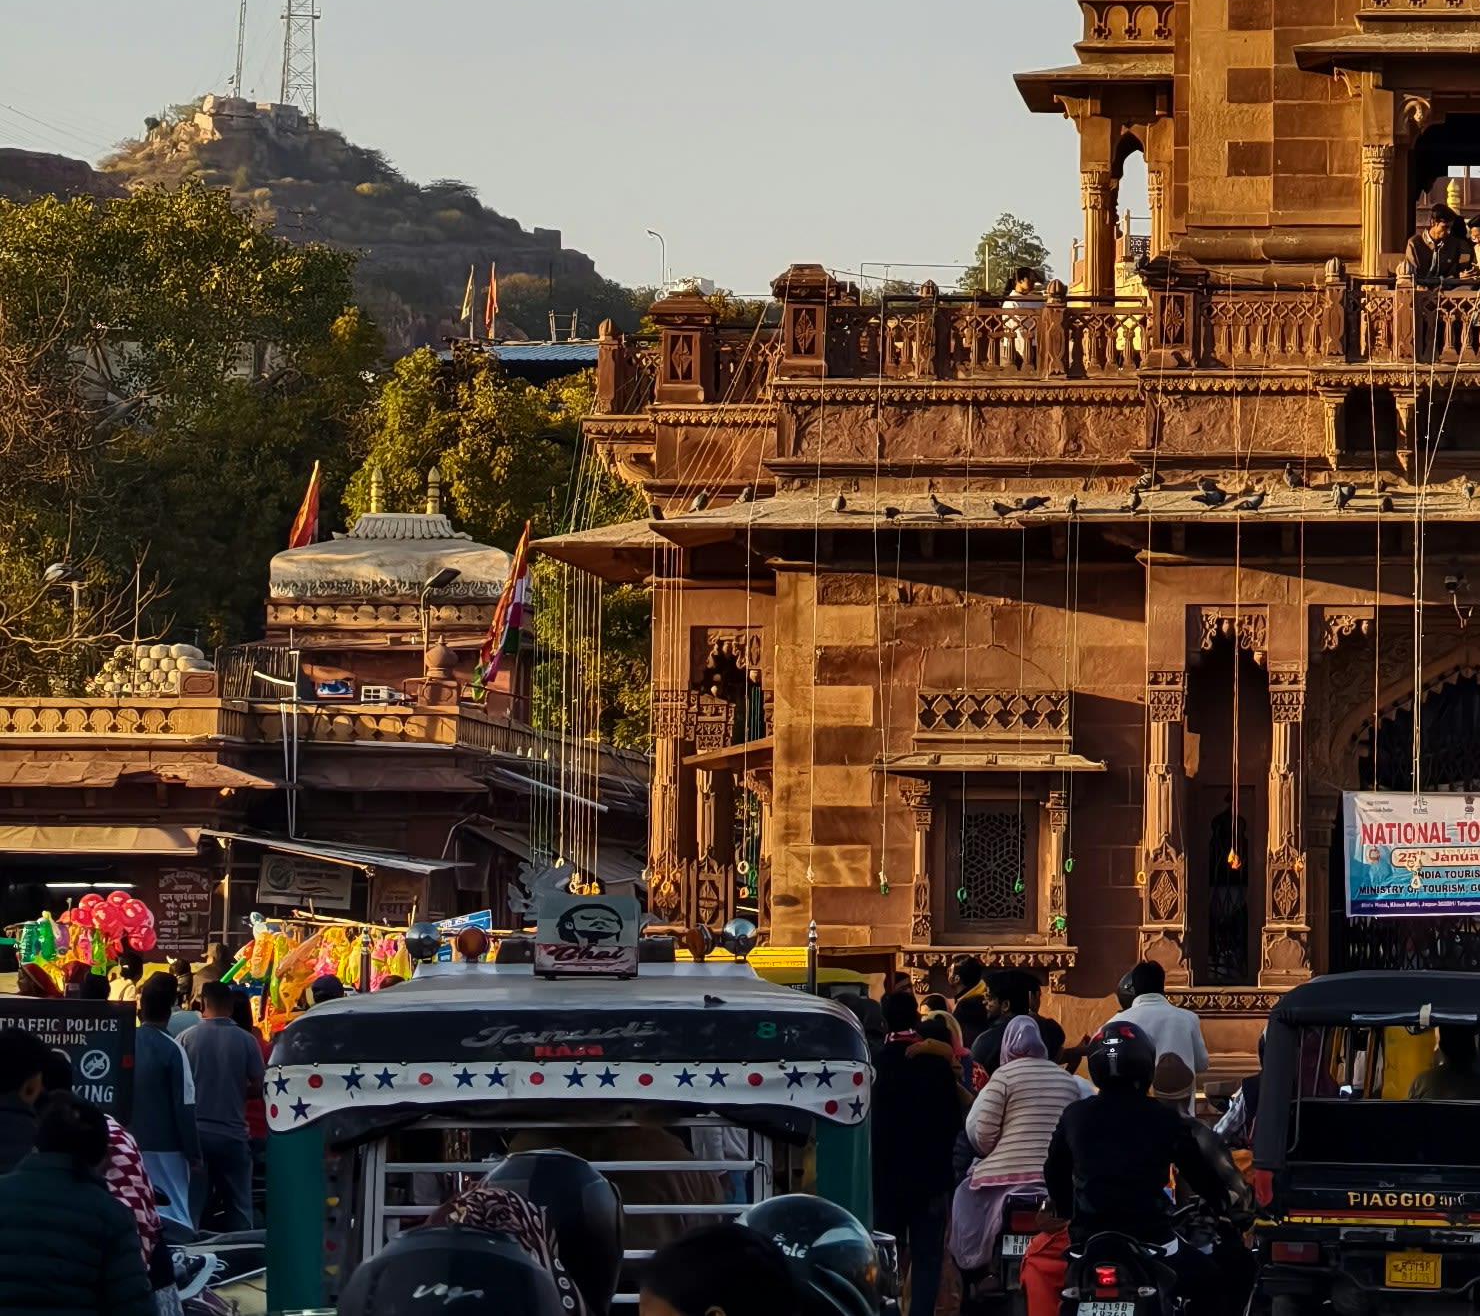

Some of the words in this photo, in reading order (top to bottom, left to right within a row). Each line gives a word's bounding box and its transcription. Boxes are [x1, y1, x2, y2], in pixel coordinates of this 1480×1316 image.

[1361, 822, 1452, 845] NATIONAL
[1417, 870, 1442, 879] NDIA
[1359, 884, 1405, 895] MINISTRY
[0, 1017, 60, 1032] TRAFFIC
[66, 1018, 118, 1032] POLICE
[40, 1034, 88, 1046] DHPUR
[71, 1084, 115, 1103] KING
[1347, 1192, 1437, 1207] PIAGGIO
